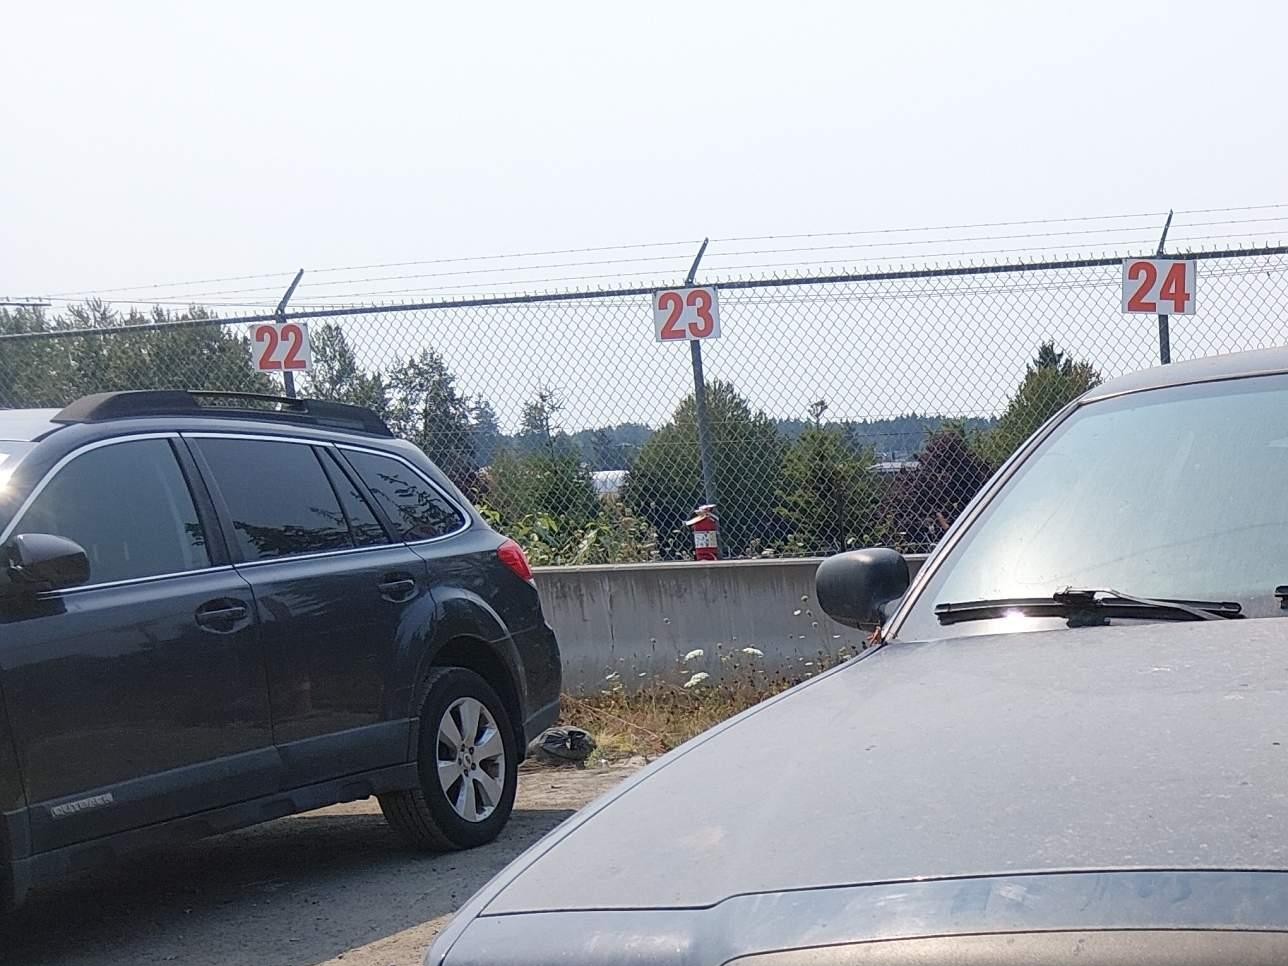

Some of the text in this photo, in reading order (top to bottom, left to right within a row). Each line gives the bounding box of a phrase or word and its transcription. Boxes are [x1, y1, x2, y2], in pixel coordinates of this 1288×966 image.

[1128, 262, 1190, 313] 24
[658, 290, 714, 338] 23
[256, 324, 306, 369] 22
